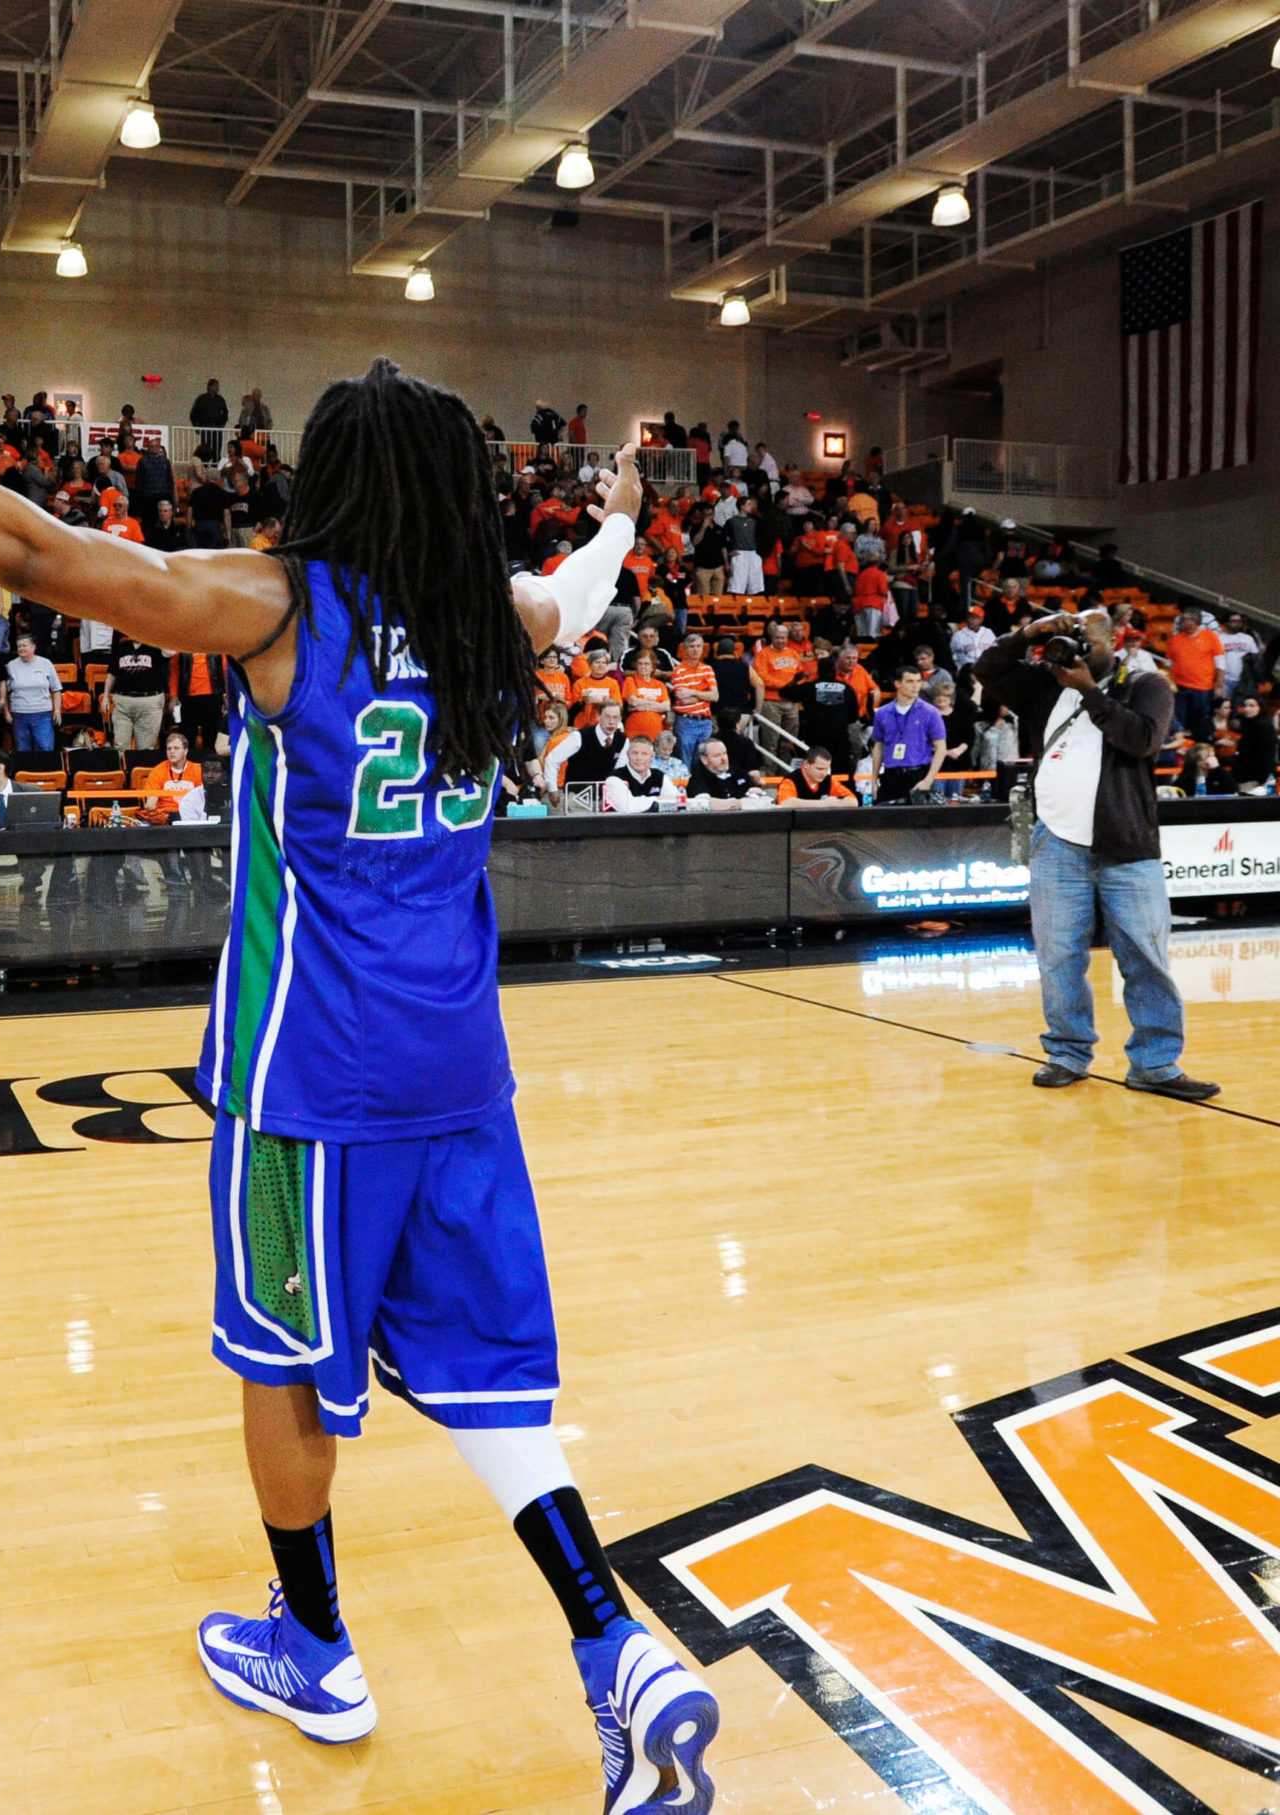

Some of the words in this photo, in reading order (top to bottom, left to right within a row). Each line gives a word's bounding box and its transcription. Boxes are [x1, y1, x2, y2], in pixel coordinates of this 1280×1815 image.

[861, 863, 967, 893] General
[968, 860, 1031, 888] Sha
[1162, 859, 1234, 879] General
